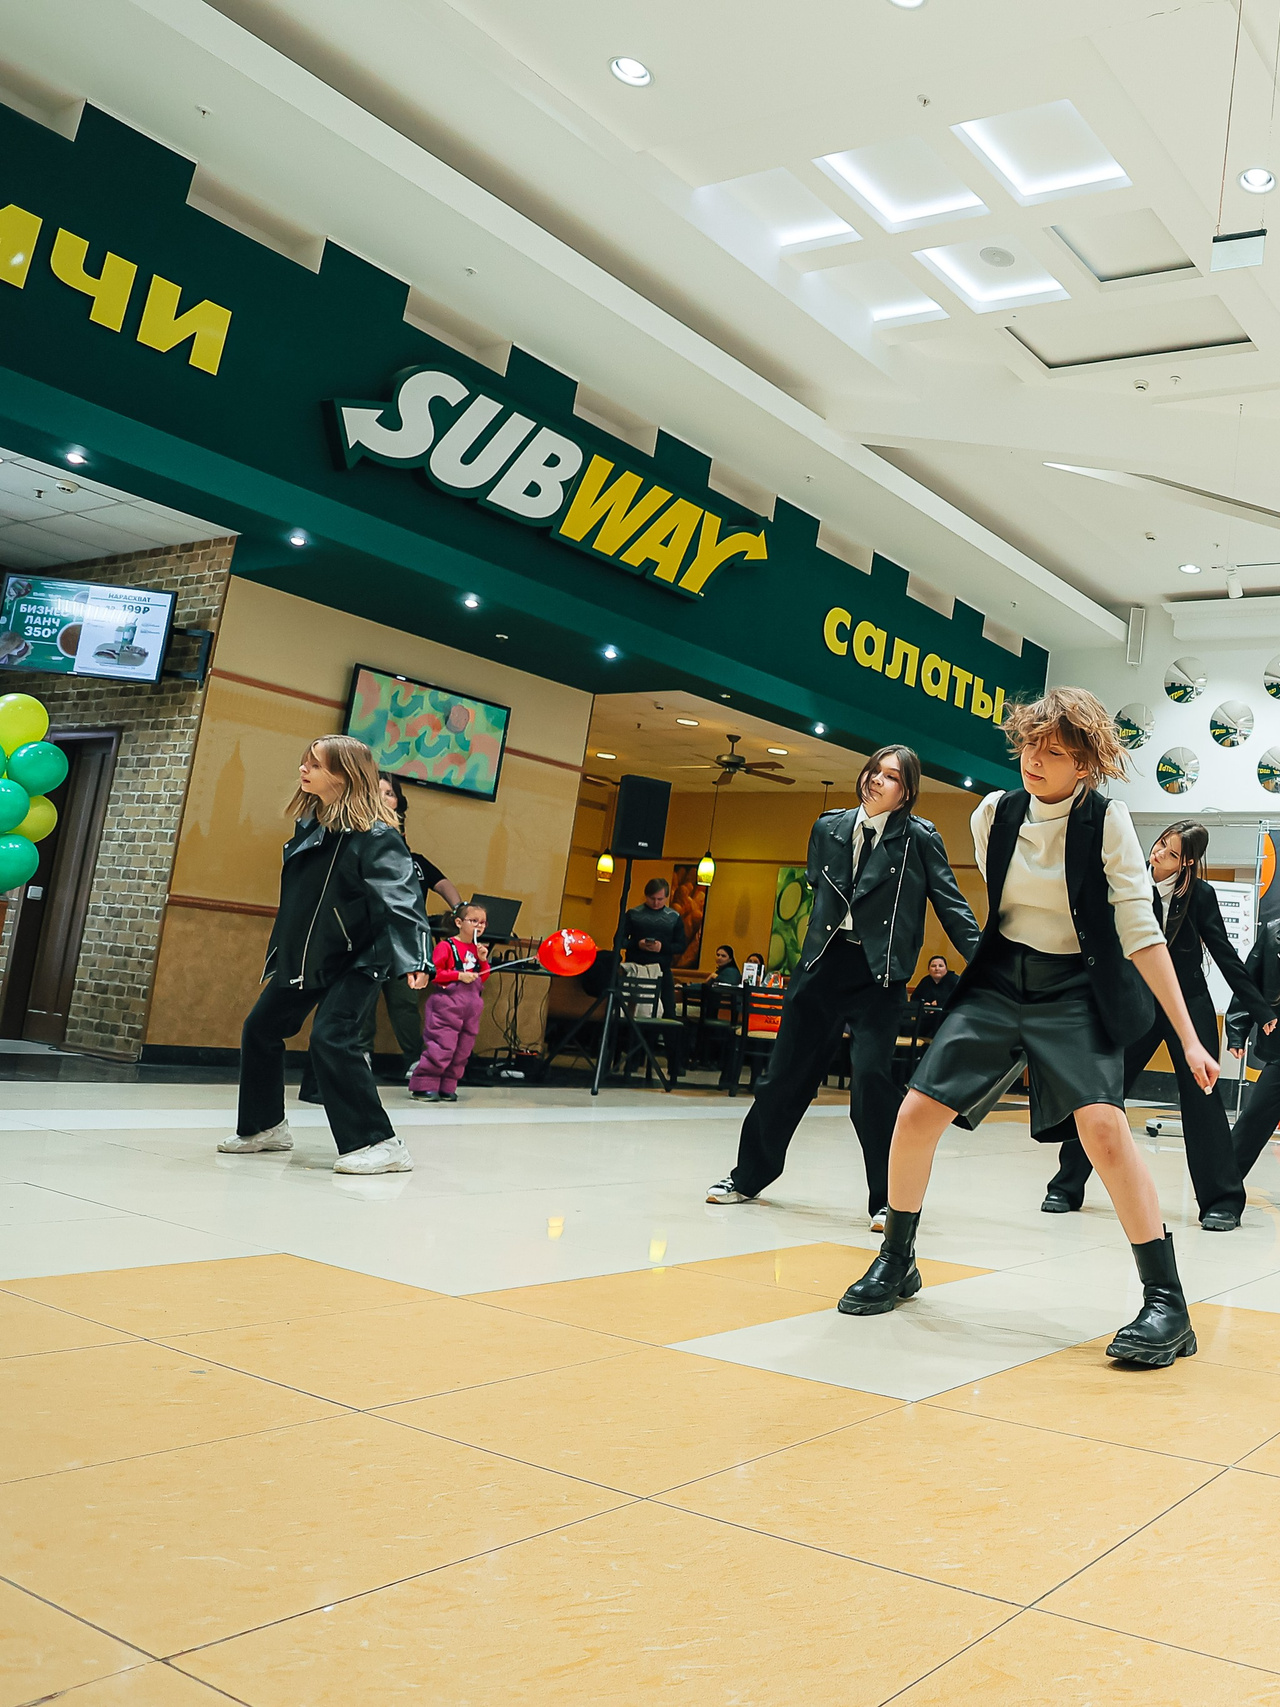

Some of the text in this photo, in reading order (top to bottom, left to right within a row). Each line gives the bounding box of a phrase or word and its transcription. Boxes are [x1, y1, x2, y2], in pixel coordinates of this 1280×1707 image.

[341, 370, 769, 595] SUBWAY
[24, 615, 61, 627] ЛАНЧ
[108, 593, 151, 603] НАРАСХВАТ
[823, 606, 1006, 726] салаты
